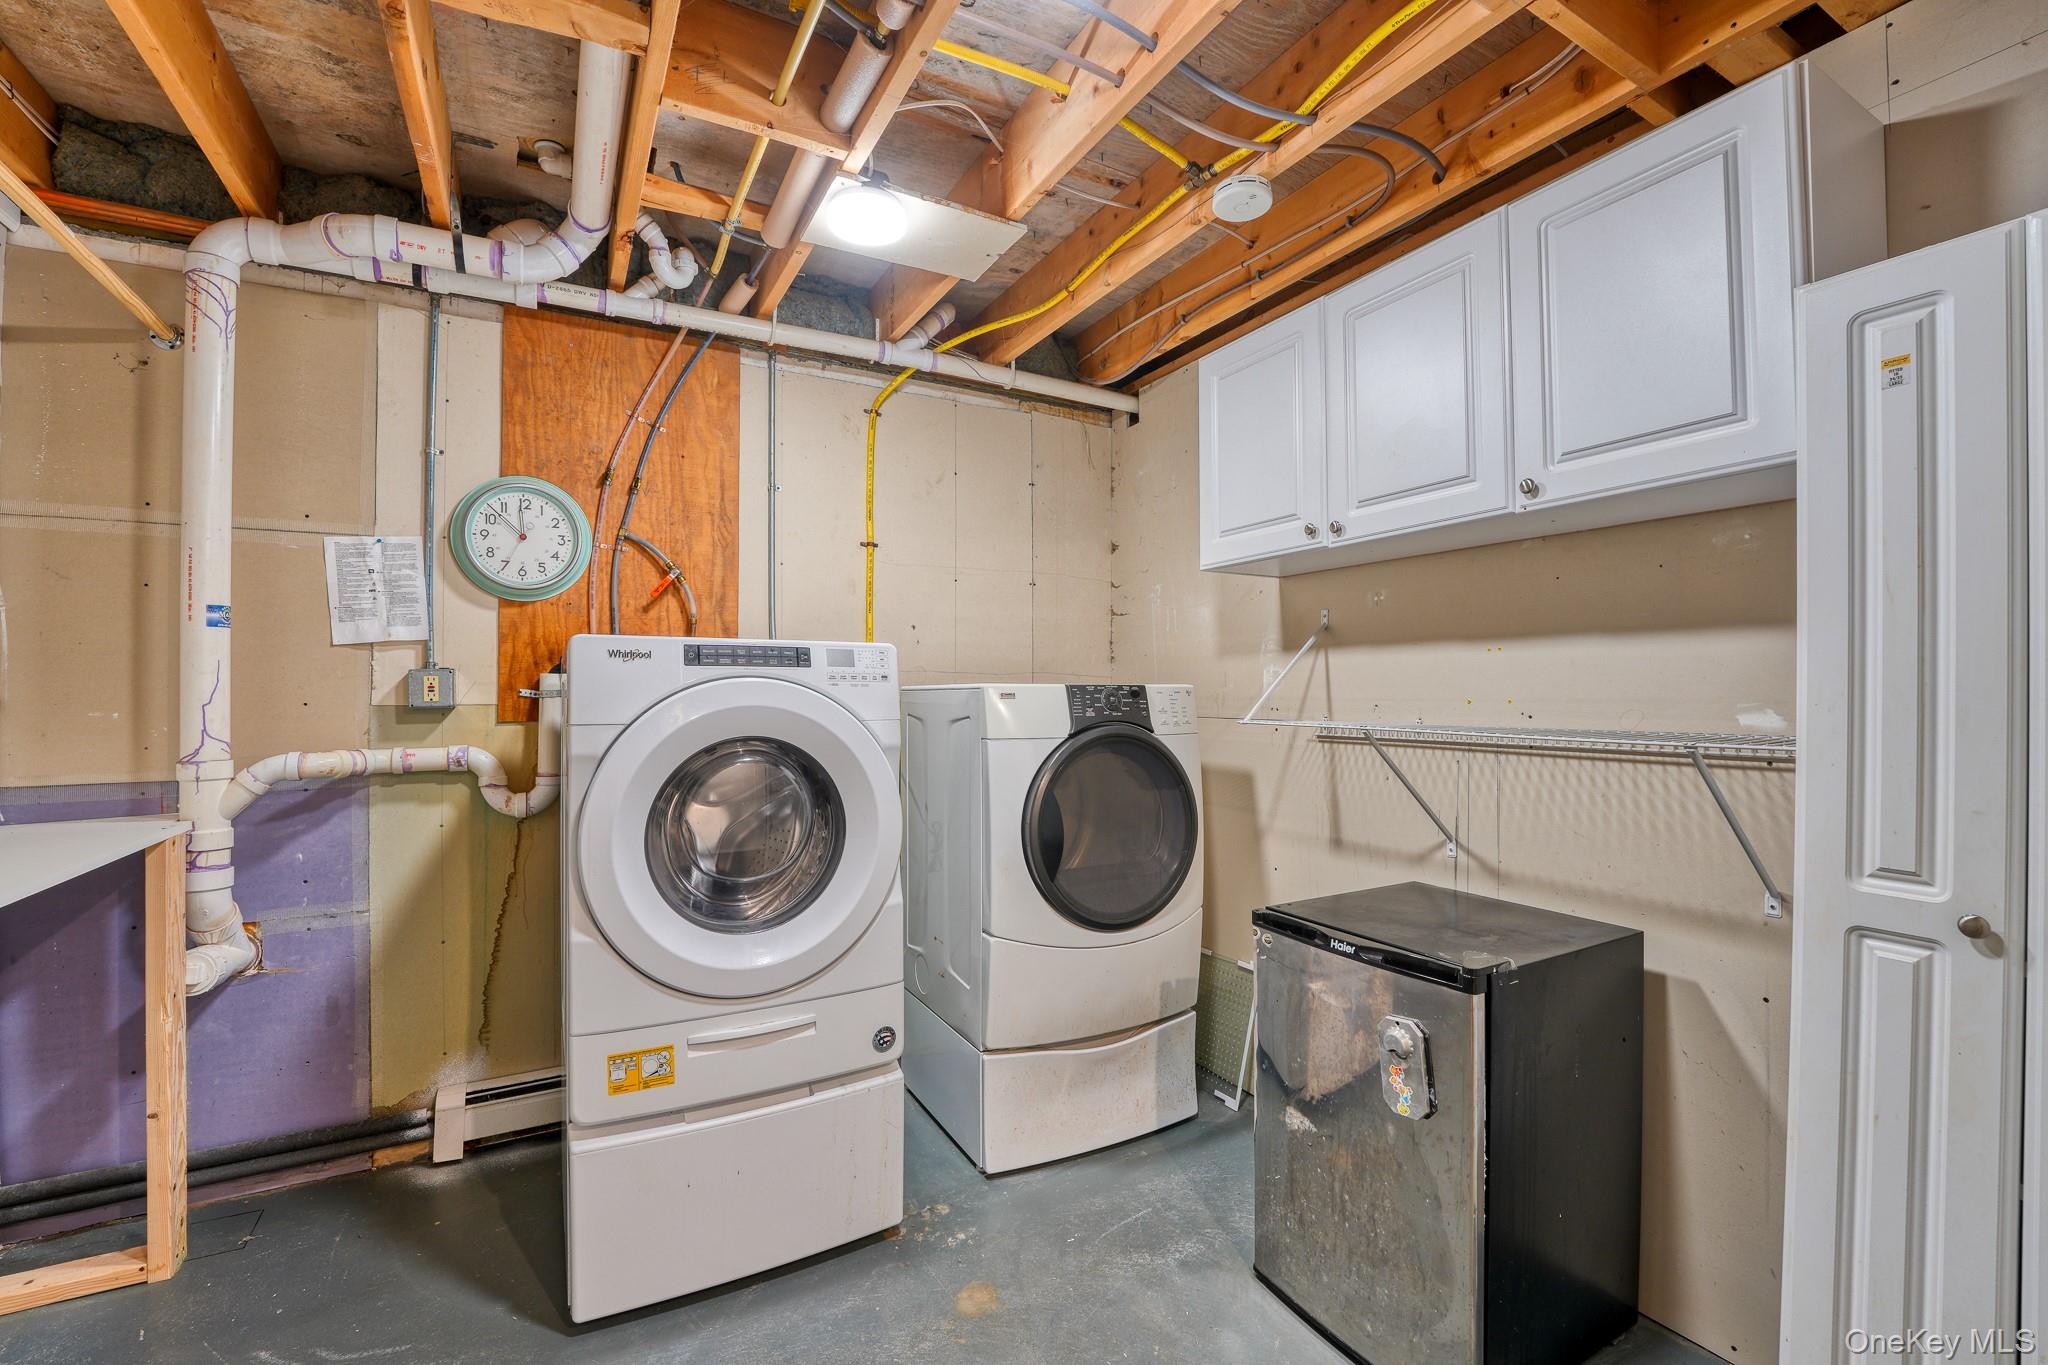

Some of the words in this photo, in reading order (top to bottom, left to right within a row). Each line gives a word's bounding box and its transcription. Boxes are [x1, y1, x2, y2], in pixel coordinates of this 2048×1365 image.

[500, 502, 508, 513] 11
[485, 513, 497, 525] 10
[551, 518, 560, 529] 2
[480, 529, 490, 540] 9
[557, 535, 566, 546] 3
[486, 547, 495, 558] 8
[550, 551, 560, 561] 4
[501, 560, 510, 571] 7
[537, 562, 546, 573] 5
[518, 566, 527, 577] 6
[607, 649, 652, 662] Whirlpool
[1330, 939, 1356, 954] Haier
